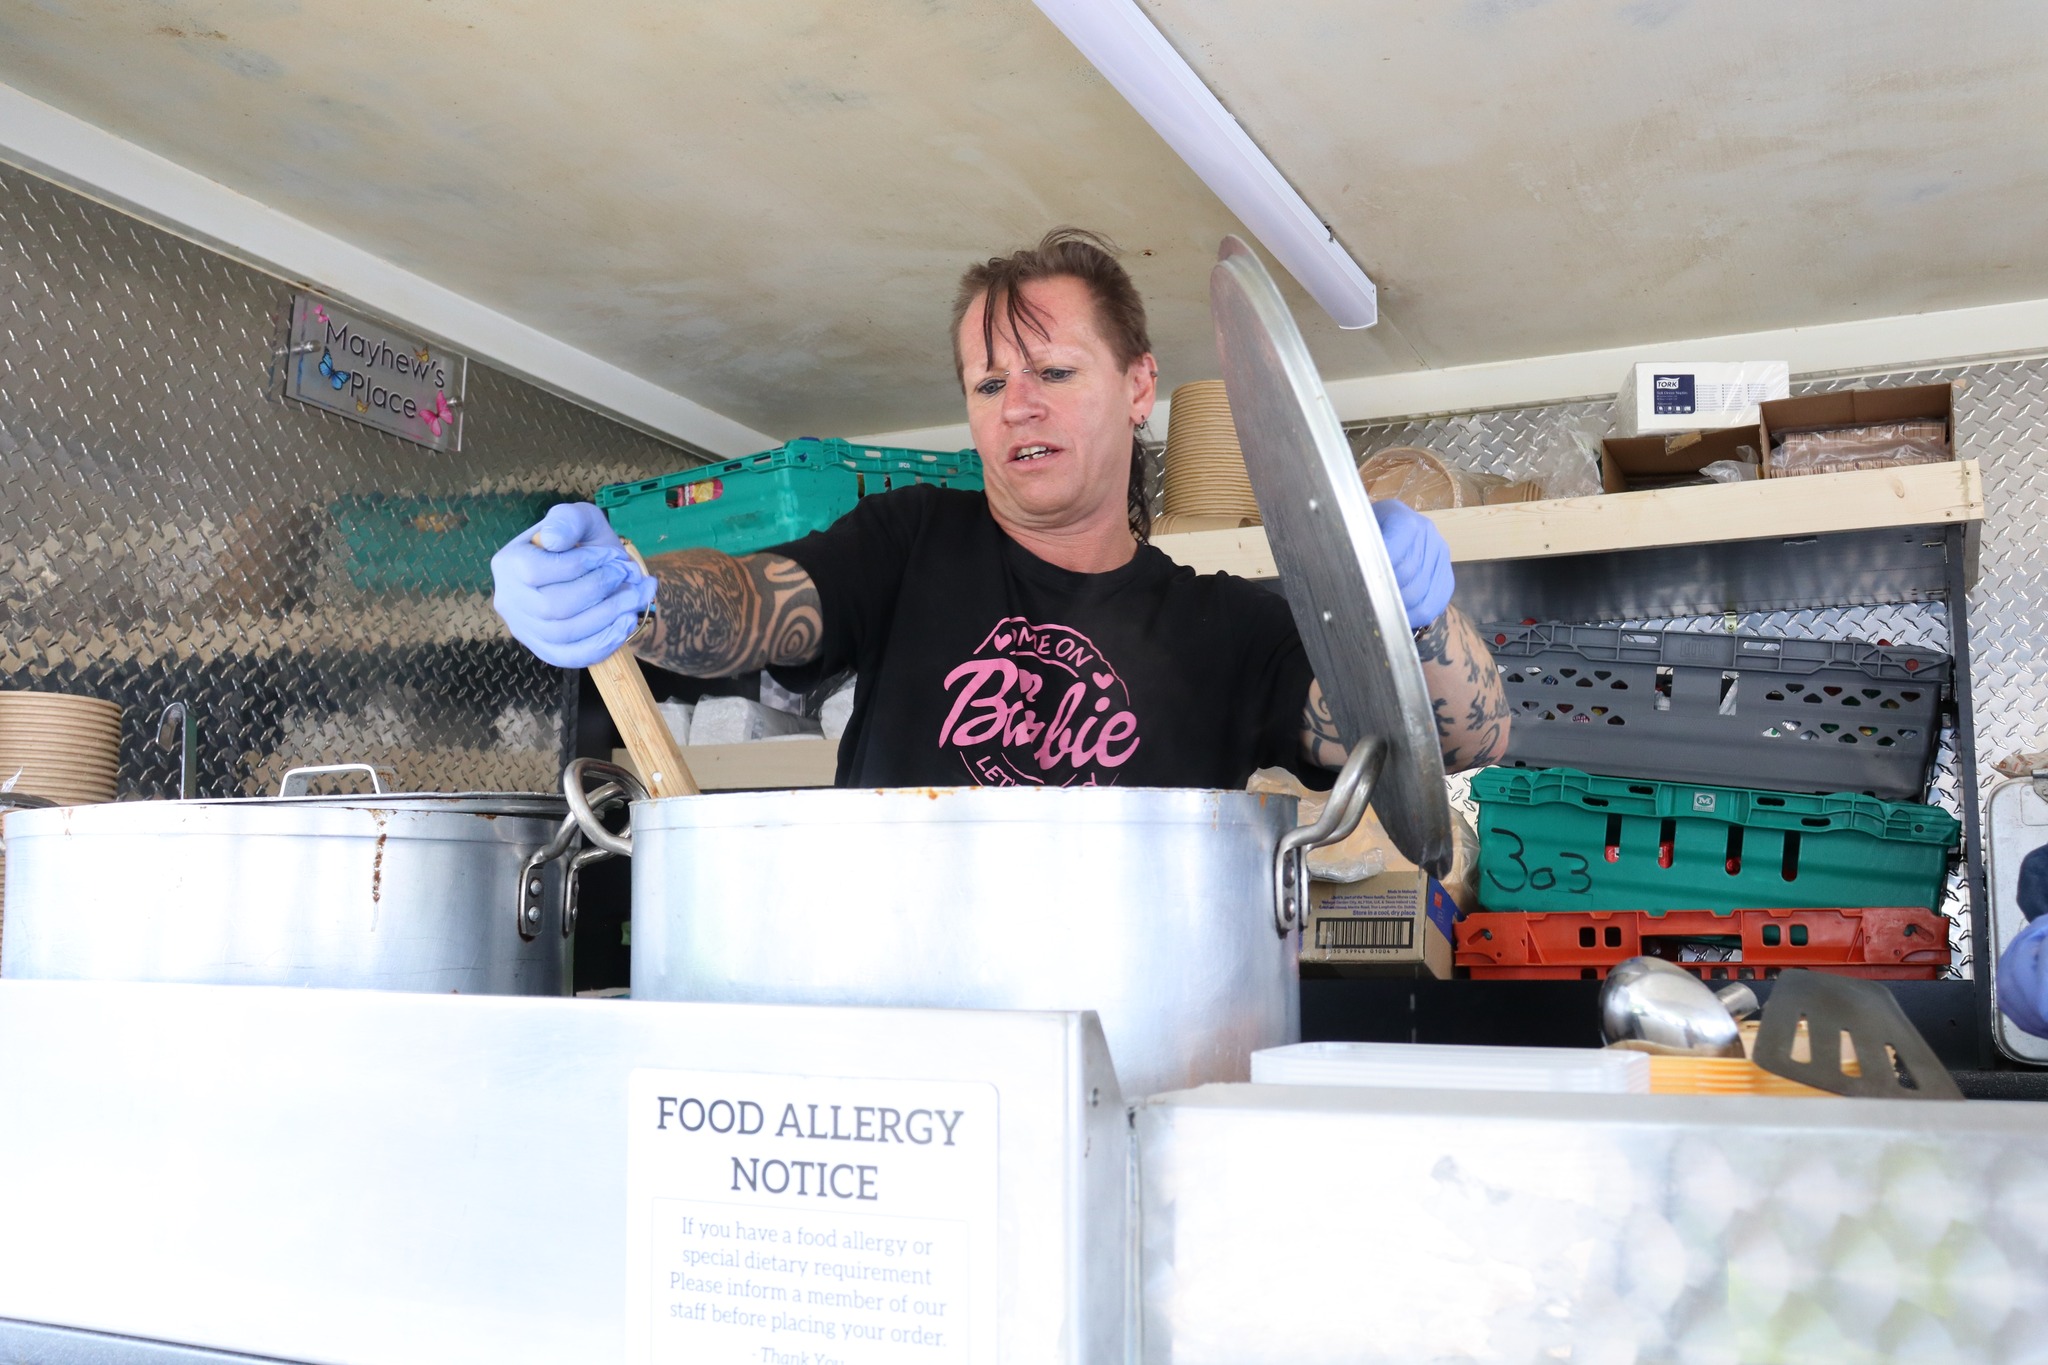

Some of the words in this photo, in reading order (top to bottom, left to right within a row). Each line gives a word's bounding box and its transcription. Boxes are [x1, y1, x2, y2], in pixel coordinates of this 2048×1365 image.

[325, 318, 445, 389] Mayhew's
[350, 370, 417, 419] Place
[1055, 638, 1094, 668] ON
[657, 1096, 764, 1135] FOOD
[775, 1103, 964, 1146] ALLERGY
[731, 1157, 878, 1200] NOTICE
[682, 1216, 694, 1235] If
[699, 1223, 730, 1239] you
[736, 1221, 778, 1242] have
[782, 1229, 791, 1244] a
[797, 1226, 837, 1248] food
[842, 1230, 907, 1257] allergy
[913, 1241, 933, 1255] or
[683, 1248, 740, 1267] special
[744, 1250, 808, 1278] dietary
[814, 1261, 931, 1285] requirement
[670, 1271, 723, 1294] Please
[727, 1277, 787, 1301] inform
[792, 1288, 801, 1303] a
[808, 1289, 884, 1311] member
[889, 1294, 908, 1313] of
[913, 1300, 947, 1317] our
[670, 1302, 707, 1321] staff
[712, 1303, 767, 1328] before
[771, 1311, 836, 1340] placing
[842, 1322, 885, 1341] your
[890, 1325, 947, 1347] order.
[761, 1346, 810, 1365] Thank
